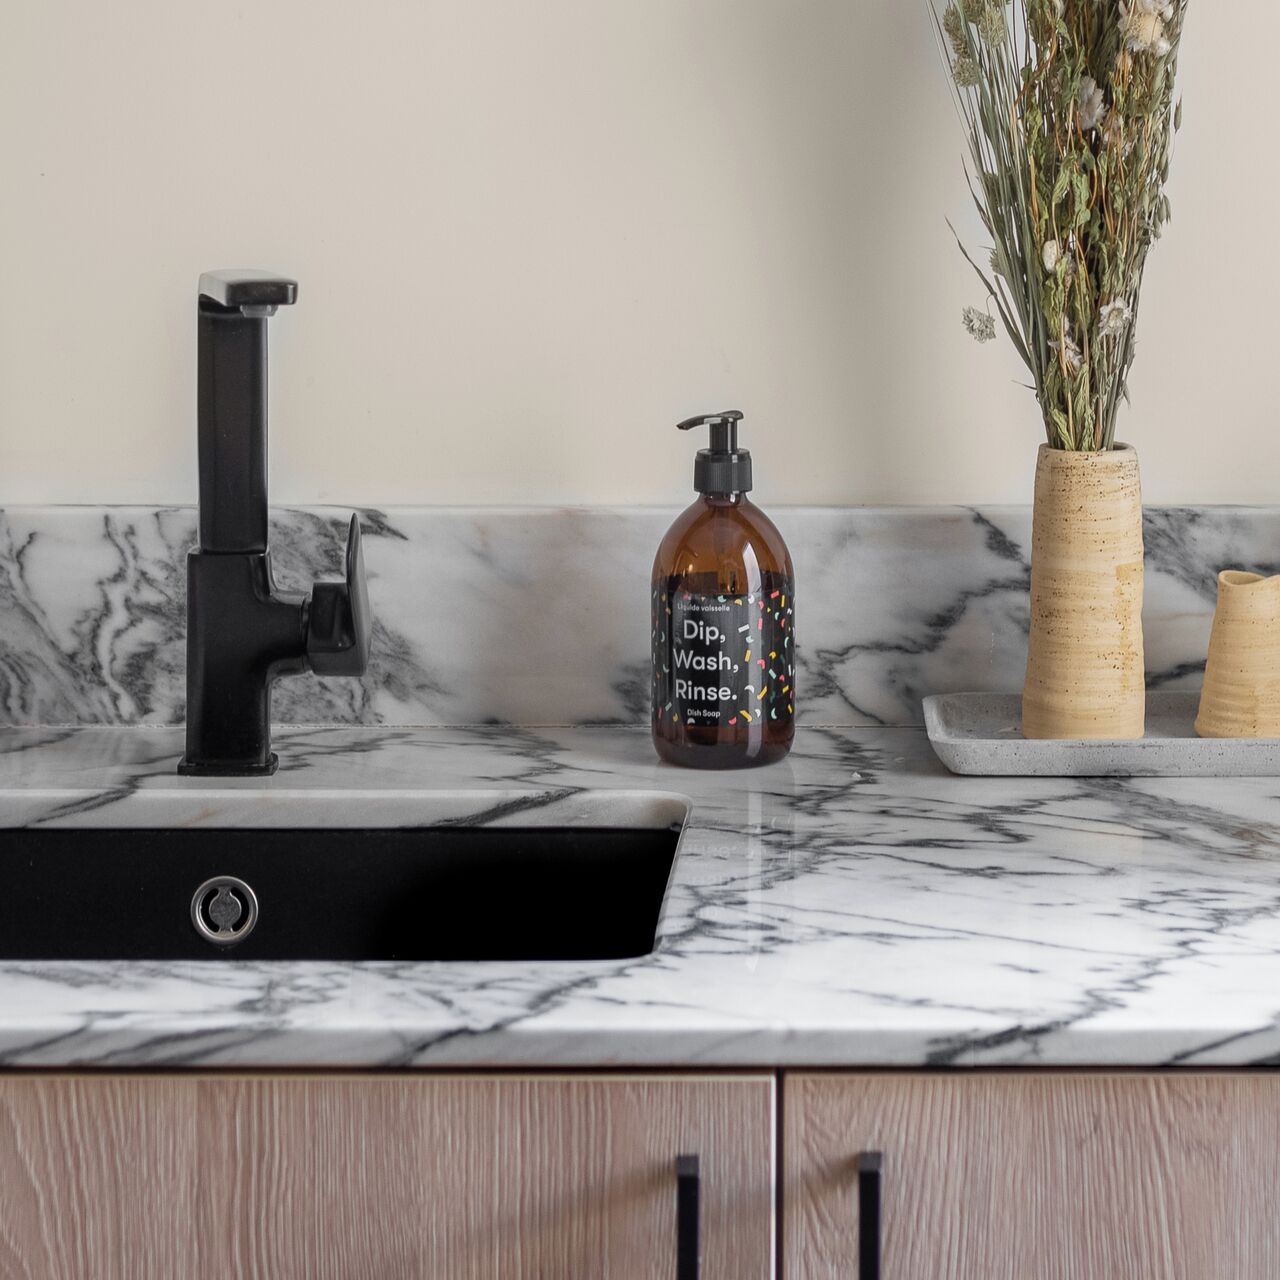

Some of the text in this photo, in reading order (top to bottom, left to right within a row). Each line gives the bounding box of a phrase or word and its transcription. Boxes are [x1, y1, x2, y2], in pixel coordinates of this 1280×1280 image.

[700, 604, 731, 613] vaisselle
[683, 619, 727, 647] Dip,
[672, 648, 740, 674] Wash,
[675, 679, 738, 702] Rinse.
[687, 708, 721, 719] Dish Soap
